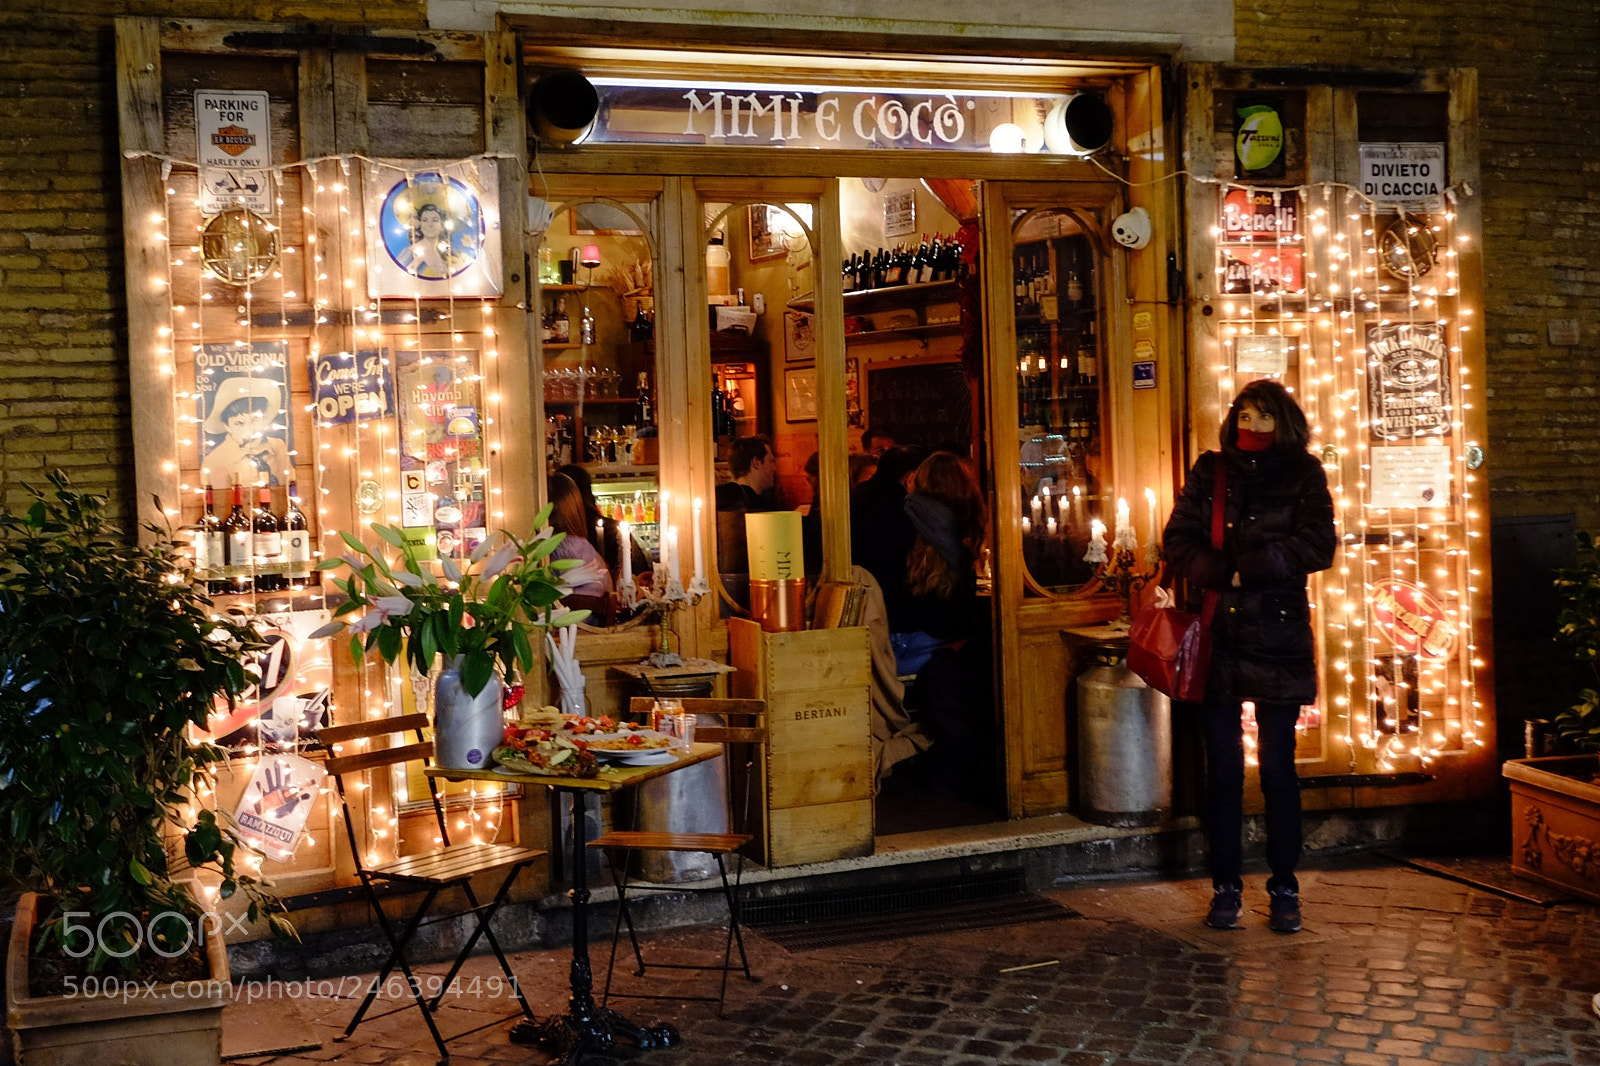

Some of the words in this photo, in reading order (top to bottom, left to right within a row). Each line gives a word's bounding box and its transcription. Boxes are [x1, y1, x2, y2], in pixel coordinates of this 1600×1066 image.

[204, 99, 259, 111] PARKING
[220, 111, 244, 122] FOR
[682, 89, 804, 141] MIMÌ
[815, 97, 842, 142] E
[852, 92, 965, 144] COCÒ
[206, 158, 238, 166] HARLEY
[240, 158, 261, 166] ONLY
[1372, 163, 1430, 177] DIVIETO
[1365, 182, 1378, 195] DI
[1382, 182, 1438, 196] CACCIA
[1252, 195, 1273, 205] oto
[1226, 203, 1294, 231] Benelli
[317, 361, 358, 386] Come
[412, 389, 463, 403] Havana
[320, 390, 388, 419] OPEN
[423, 404, 446, 417] Clu
[795, 707, 847, 720] BERTANI
